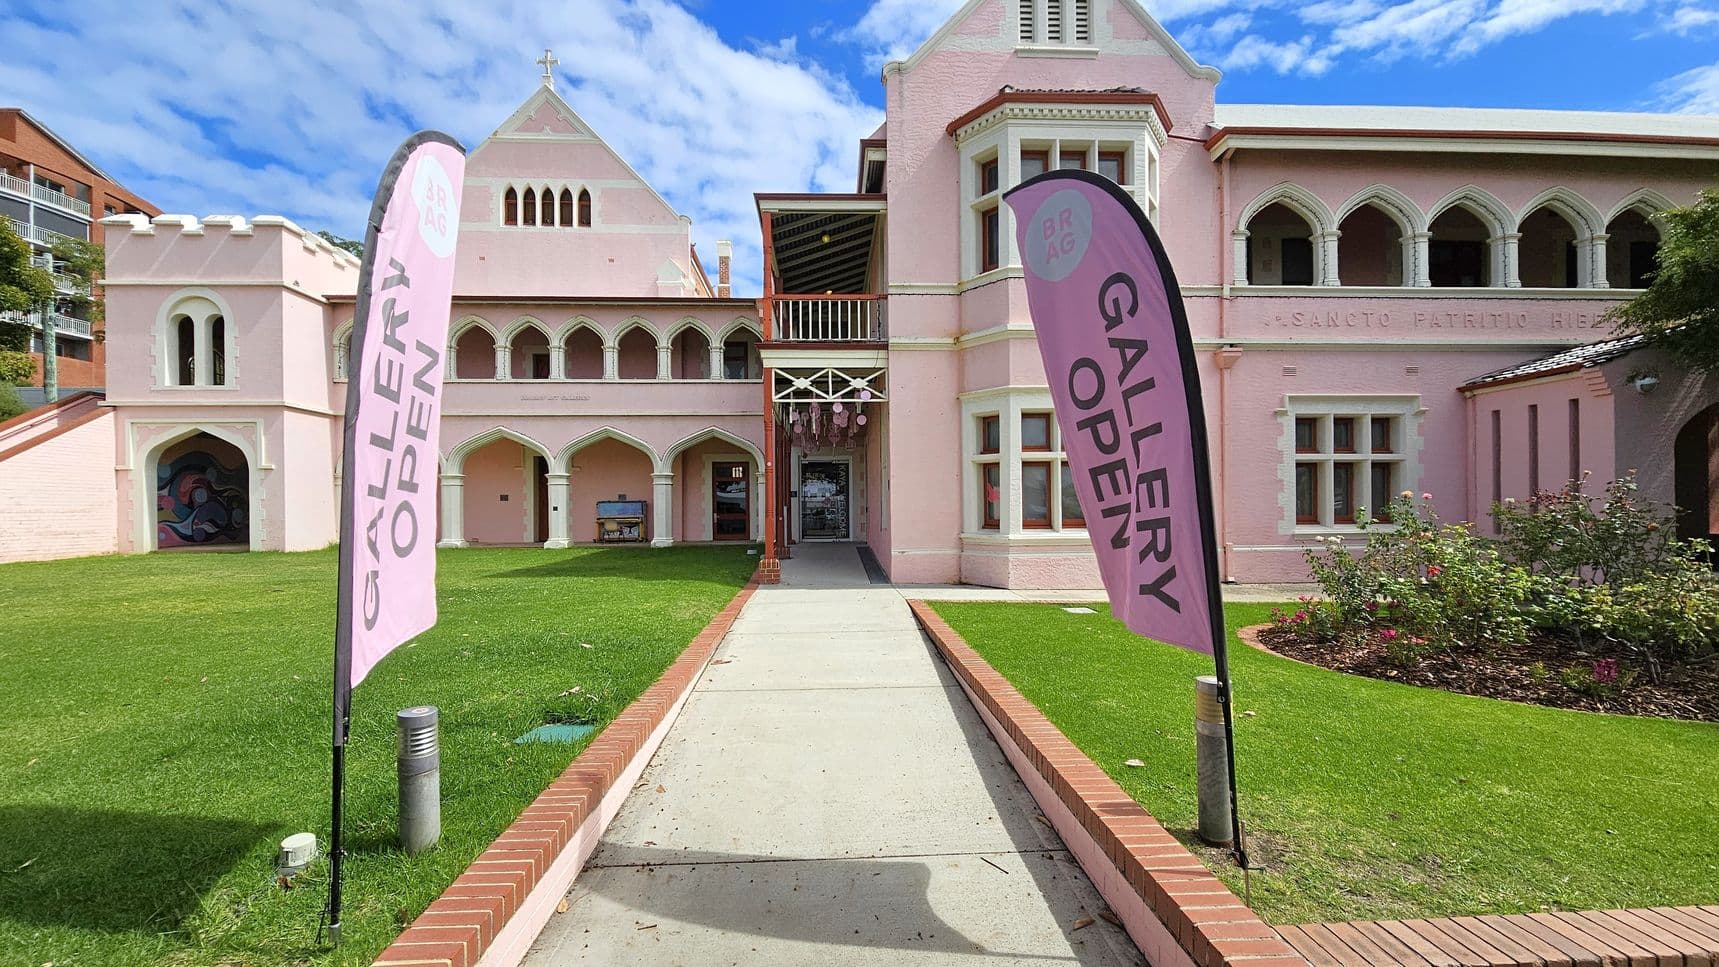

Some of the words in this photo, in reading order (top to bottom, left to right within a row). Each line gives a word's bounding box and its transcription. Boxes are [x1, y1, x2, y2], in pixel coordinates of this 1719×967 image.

[424, 209, 448, 238] AG
[1041, 207, 1073, 241] BR
[1045, 232, 1076, 265] AG
[1291, 311, 1392, 328] SANCTO
[1414, 311, 1527, 329] PATRITIO
[363, 256, 411, 632] GALLERY
[391, 338, 440, 559] OPEN
[1068, 356, 1133, 551] OPEN
[1098, 271, 1181, 615] GALLERY
[838, 494, 848, 537] WELCOME
